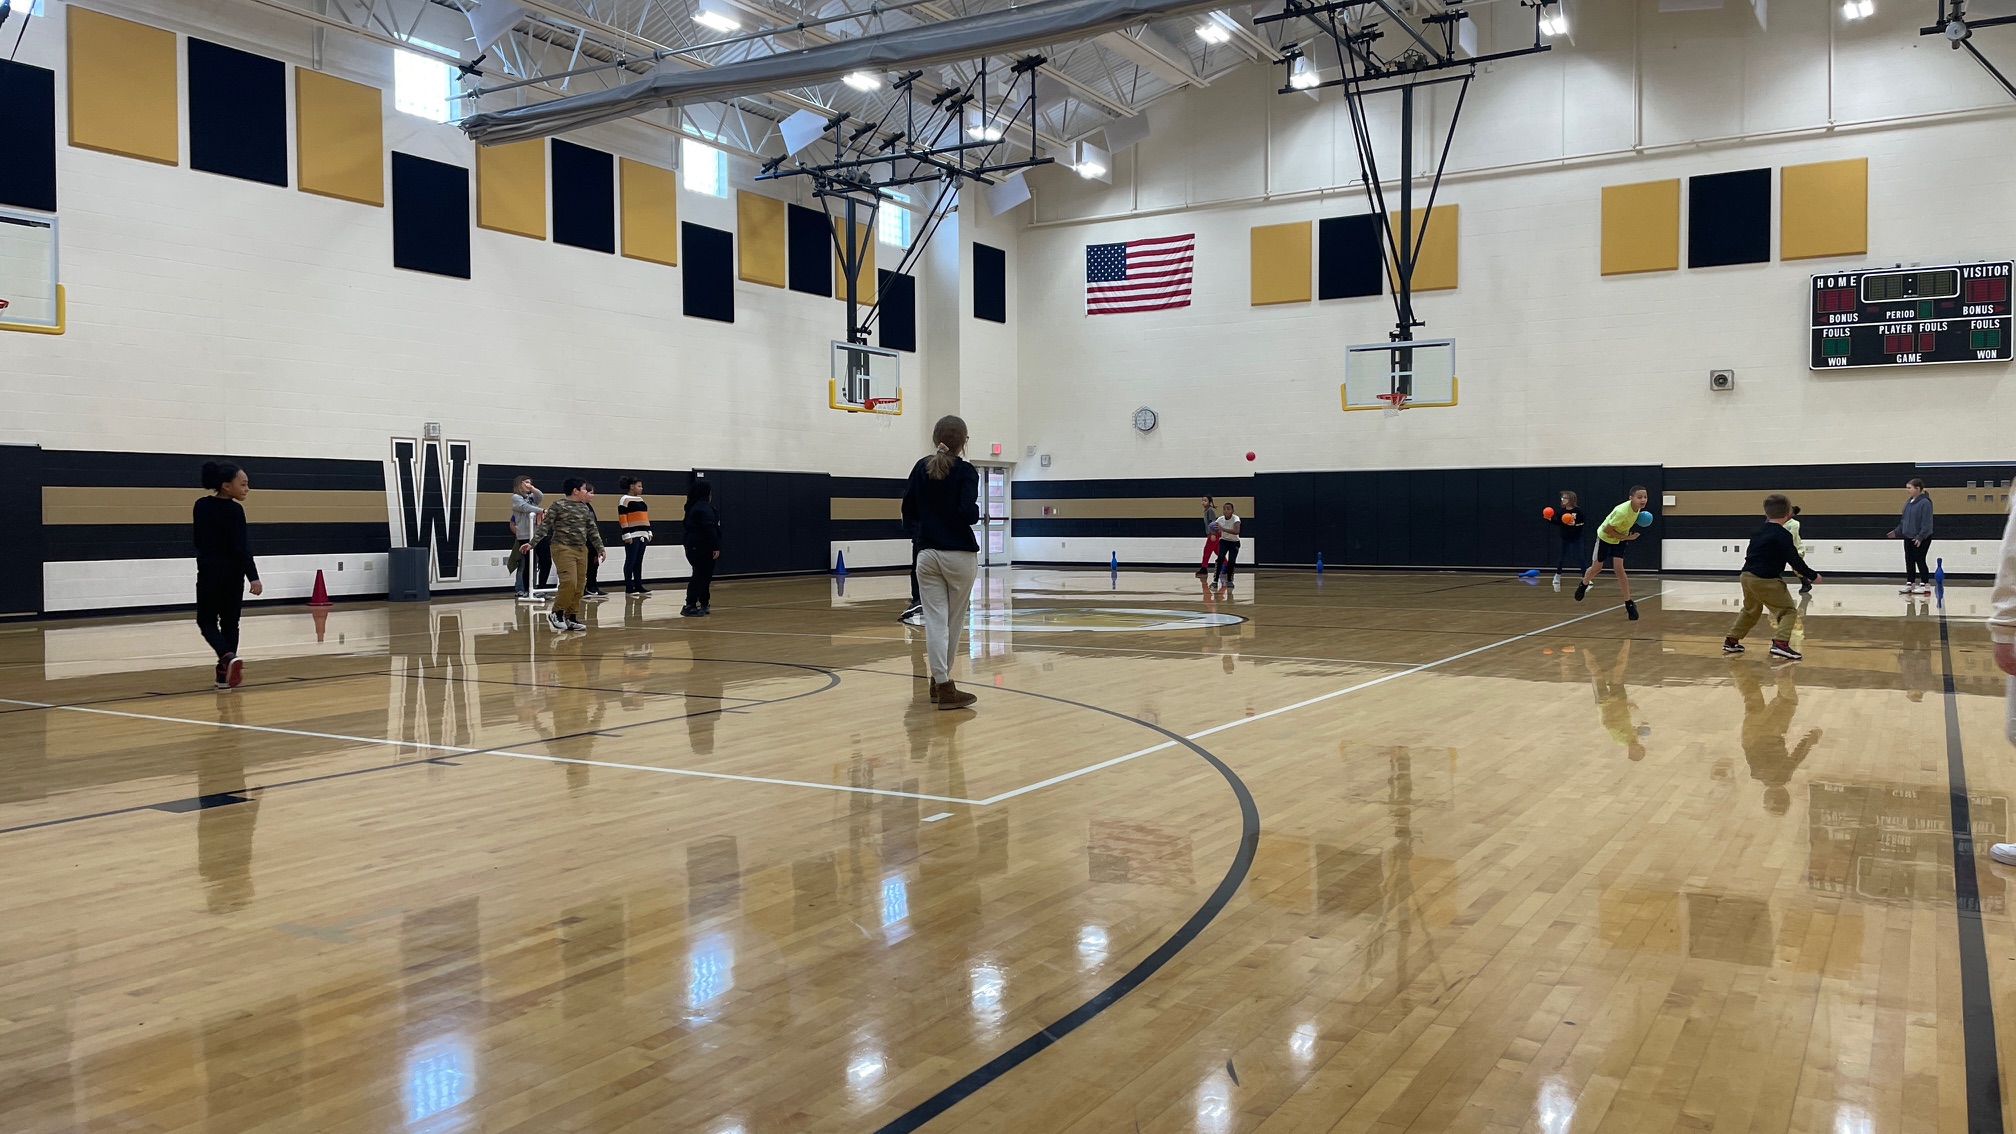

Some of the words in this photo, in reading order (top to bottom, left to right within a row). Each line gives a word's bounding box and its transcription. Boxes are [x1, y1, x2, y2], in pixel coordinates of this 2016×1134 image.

[1963, 265, 2009, 278] VISITOR
[1817, 276, 1857, 289] HOME
[1886, 310, 1915, 319] PERIOD
[1963, 305, 1994, 315] BONUS
[1829, 313, 1859, 323] BONUS
[1879, 324, 1913, 334] PLAYER
[1920, 322, 1948, 332] FOULS
[1970, 319, 2000, 330] FOULS
[1823, 328, 1851, 338] FOULS
[1896, 353, 1922, 363] GAME
[1977, 350, 1997, 360] WON
[1828, 357, 1847, 366] WON
[390, 437, 470, 583] W
